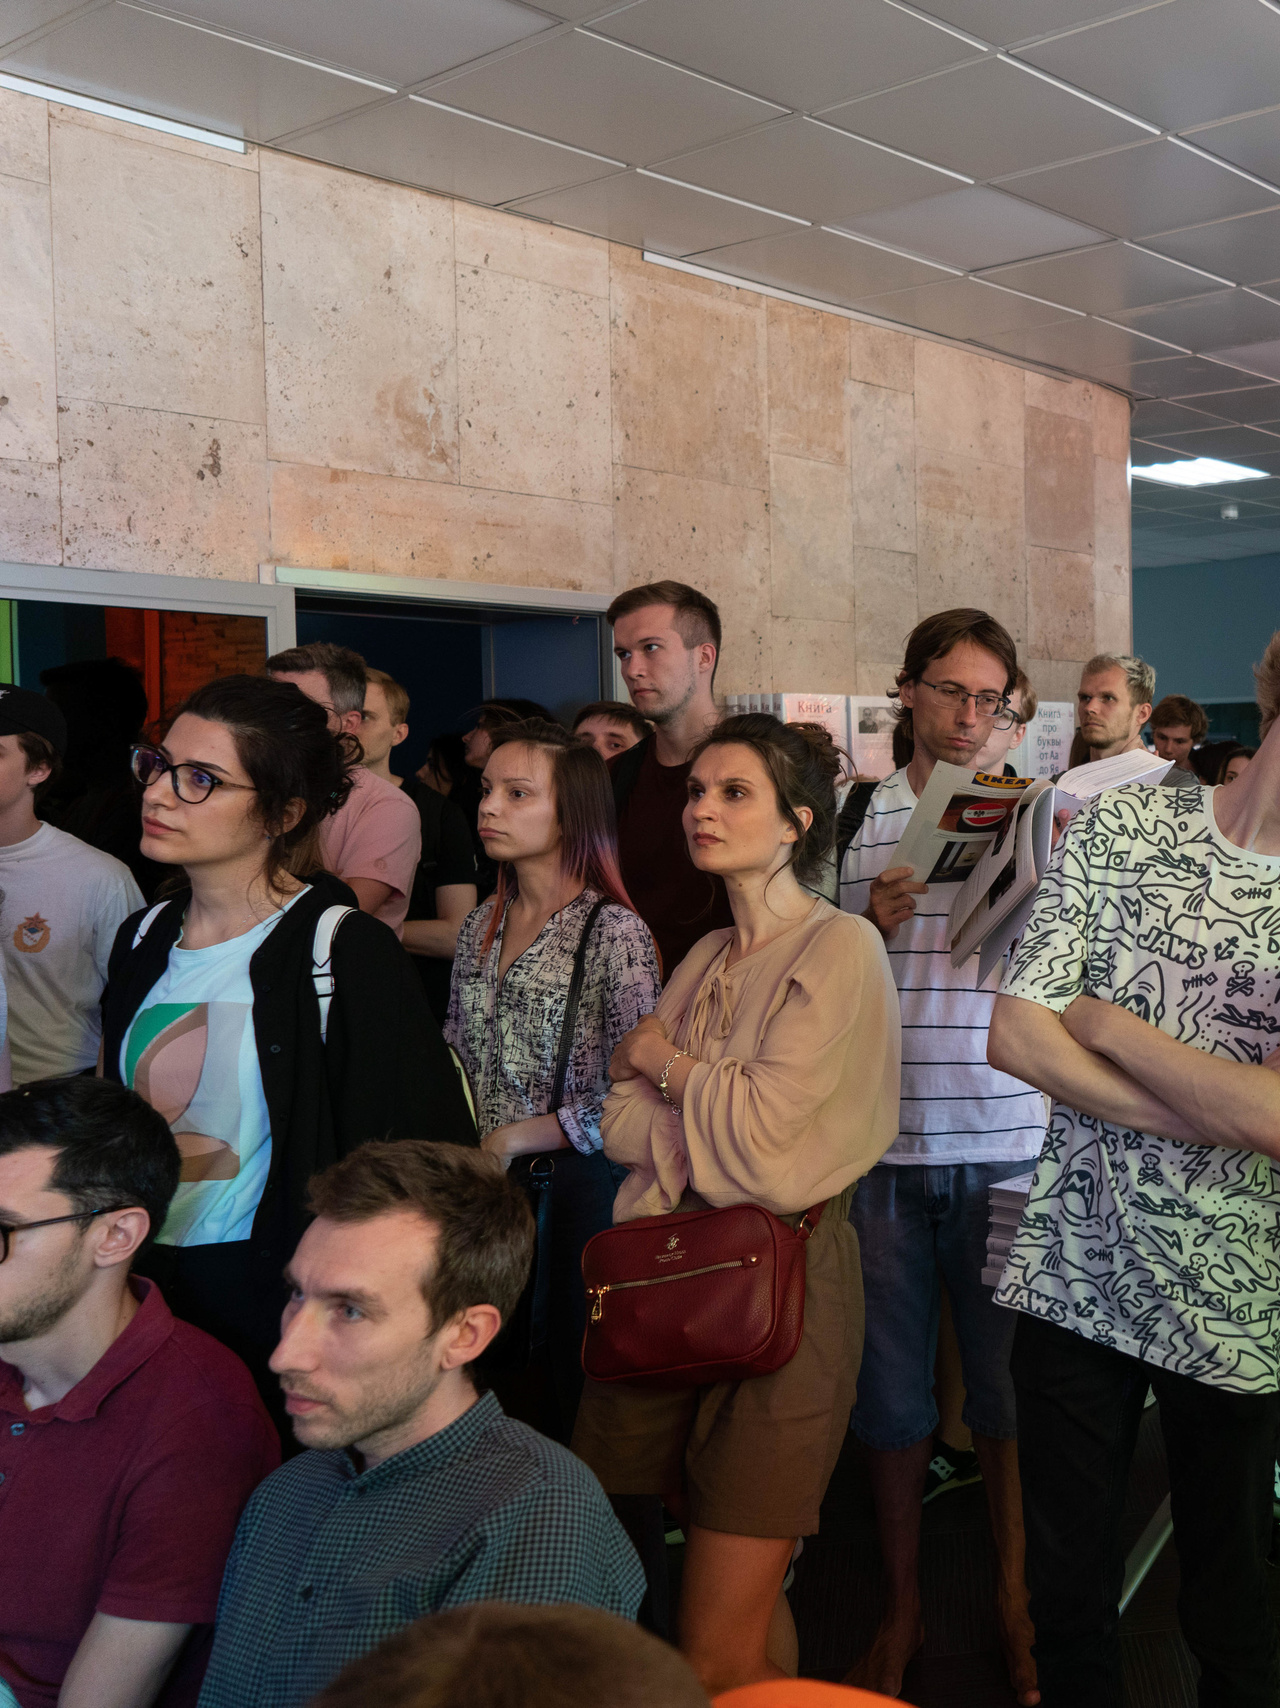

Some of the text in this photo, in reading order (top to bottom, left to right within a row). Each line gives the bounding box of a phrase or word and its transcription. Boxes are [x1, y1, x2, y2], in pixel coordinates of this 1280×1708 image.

[797, 701, 832, 713] Книга
[1037, 708, 1061, 719] Книга
[1042, 724, 1057, 736] про
[1036, 735, 1061, 749] буквы
[1039, 750, 1059, 761] от Аа
[1038, 766, 1048, 775] до
[982, 775, 1027, 785] IKEA
[1136, 925, 1208, 970] JAWS
[1154, 1279, 1227, 1312] JAWS
[995, 1282, 1069, 1323] JAWS
